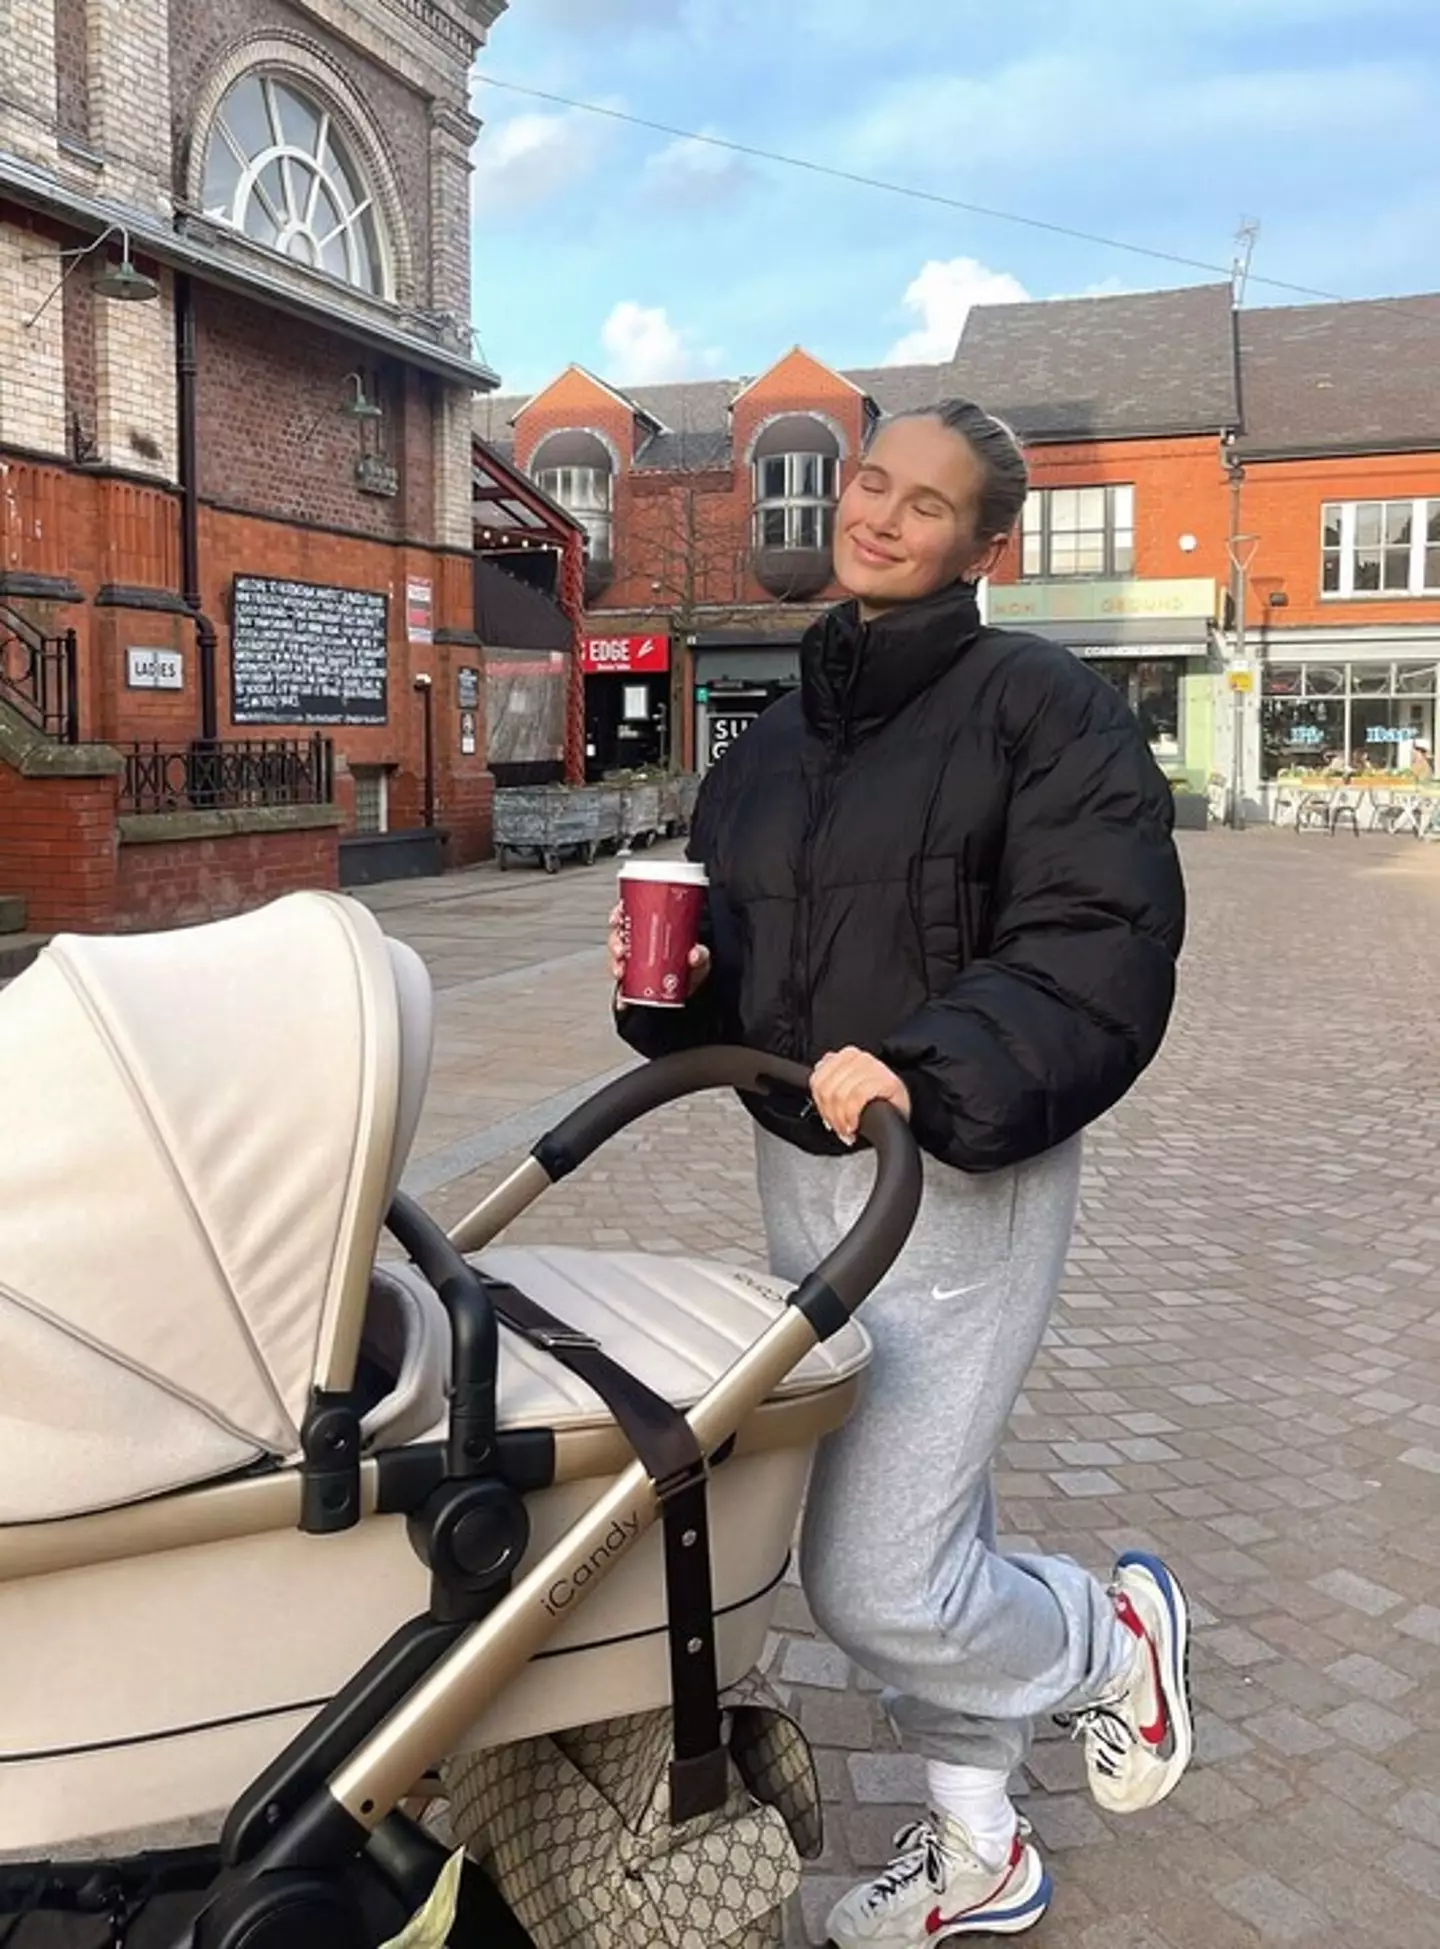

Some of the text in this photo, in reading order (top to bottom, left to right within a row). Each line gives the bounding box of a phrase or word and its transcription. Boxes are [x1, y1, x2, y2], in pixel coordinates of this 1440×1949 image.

[590, 640, 630, 661] EDGE
[134, 661, 176, 678] LADIES
[540, 1510, 639, 1617] iCandy
